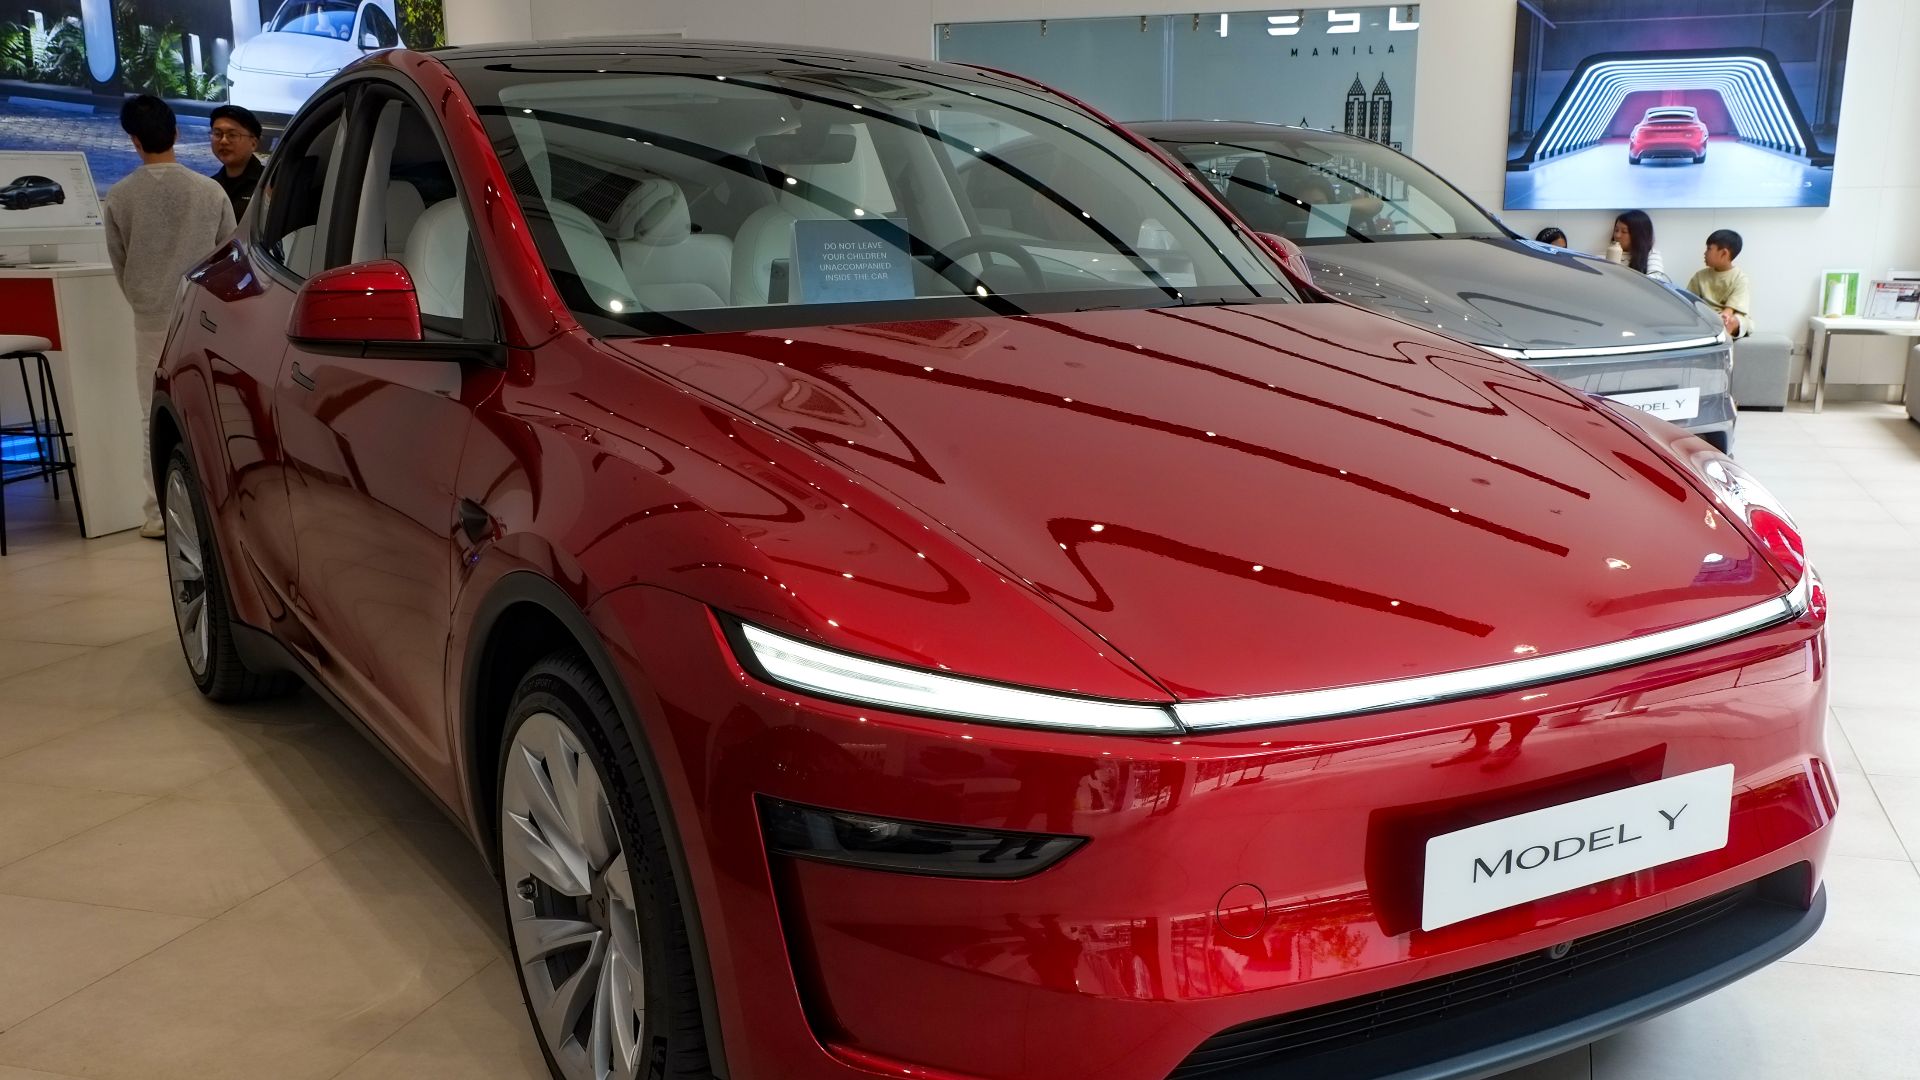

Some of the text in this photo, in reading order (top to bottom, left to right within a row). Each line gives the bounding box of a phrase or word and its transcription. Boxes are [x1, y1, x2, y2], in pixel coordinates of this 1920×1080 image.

[1290, 44, 1395, 57] MANILA
[847, 252, 887, 260] CHILDREN
[820, 263, 891, 271] UNACCOMPANIED
[1632, 399, 1686, 412] ODEL Y
[1473, 803, 1688, 883] MODEL Y
